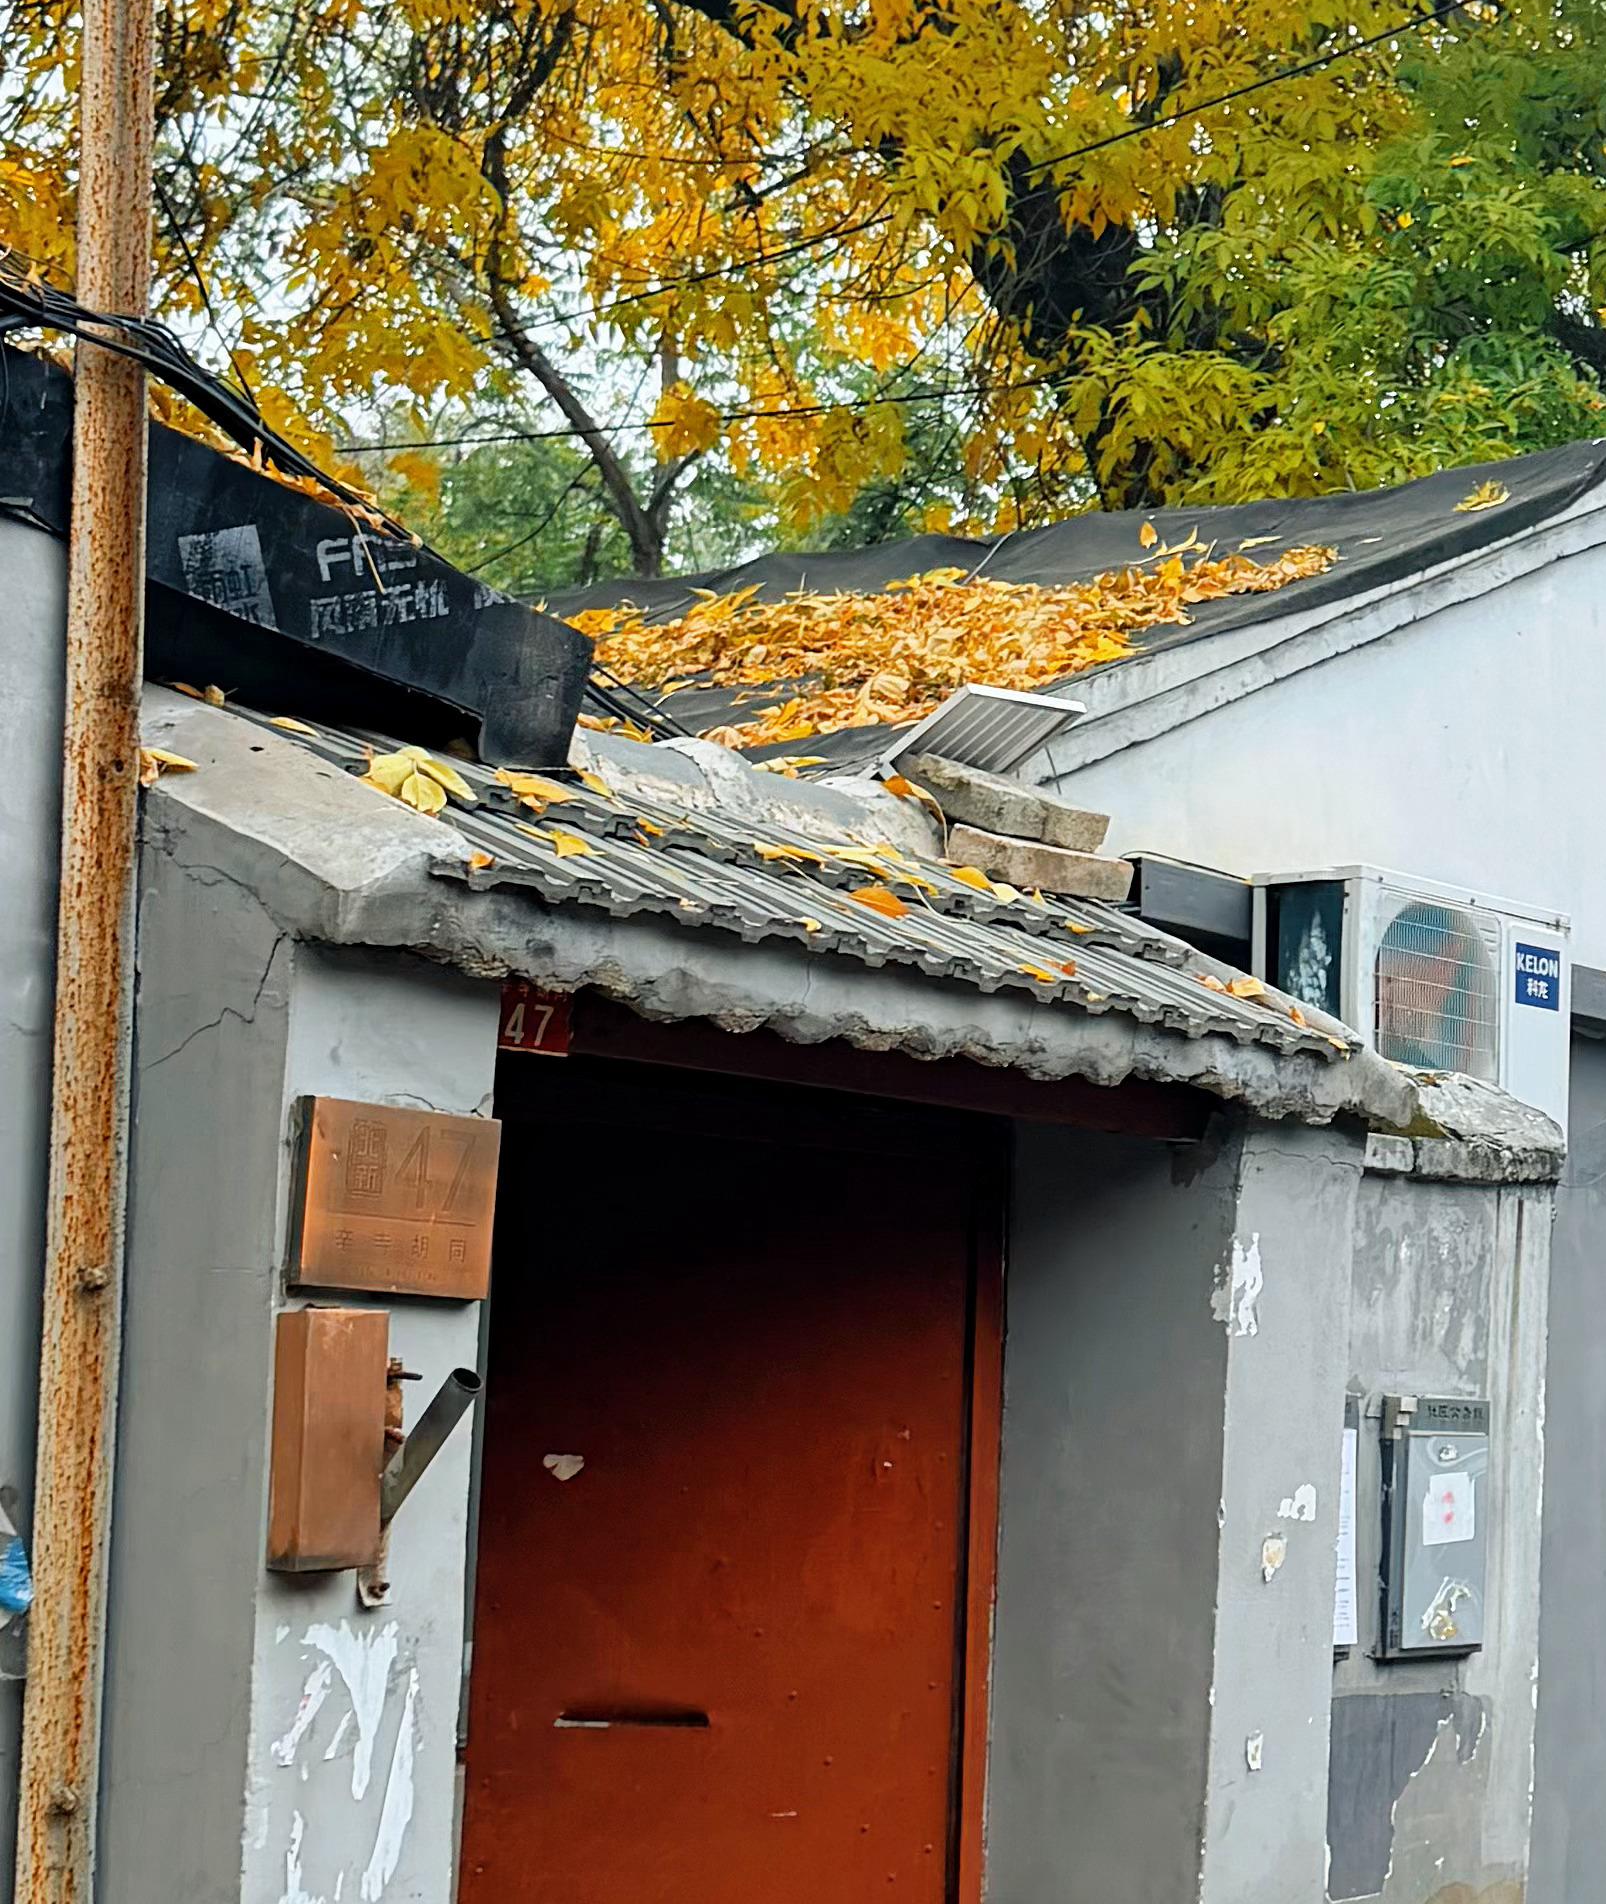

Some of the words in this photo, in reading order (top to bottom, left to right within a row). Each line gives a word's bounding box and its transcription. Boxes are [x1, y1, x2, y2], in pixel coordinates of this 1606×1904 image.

[1516, 952, 1558, 978] KELON
[504, 1003, 555, 1047] 47
[394, 1125, 477, 1214] 47
